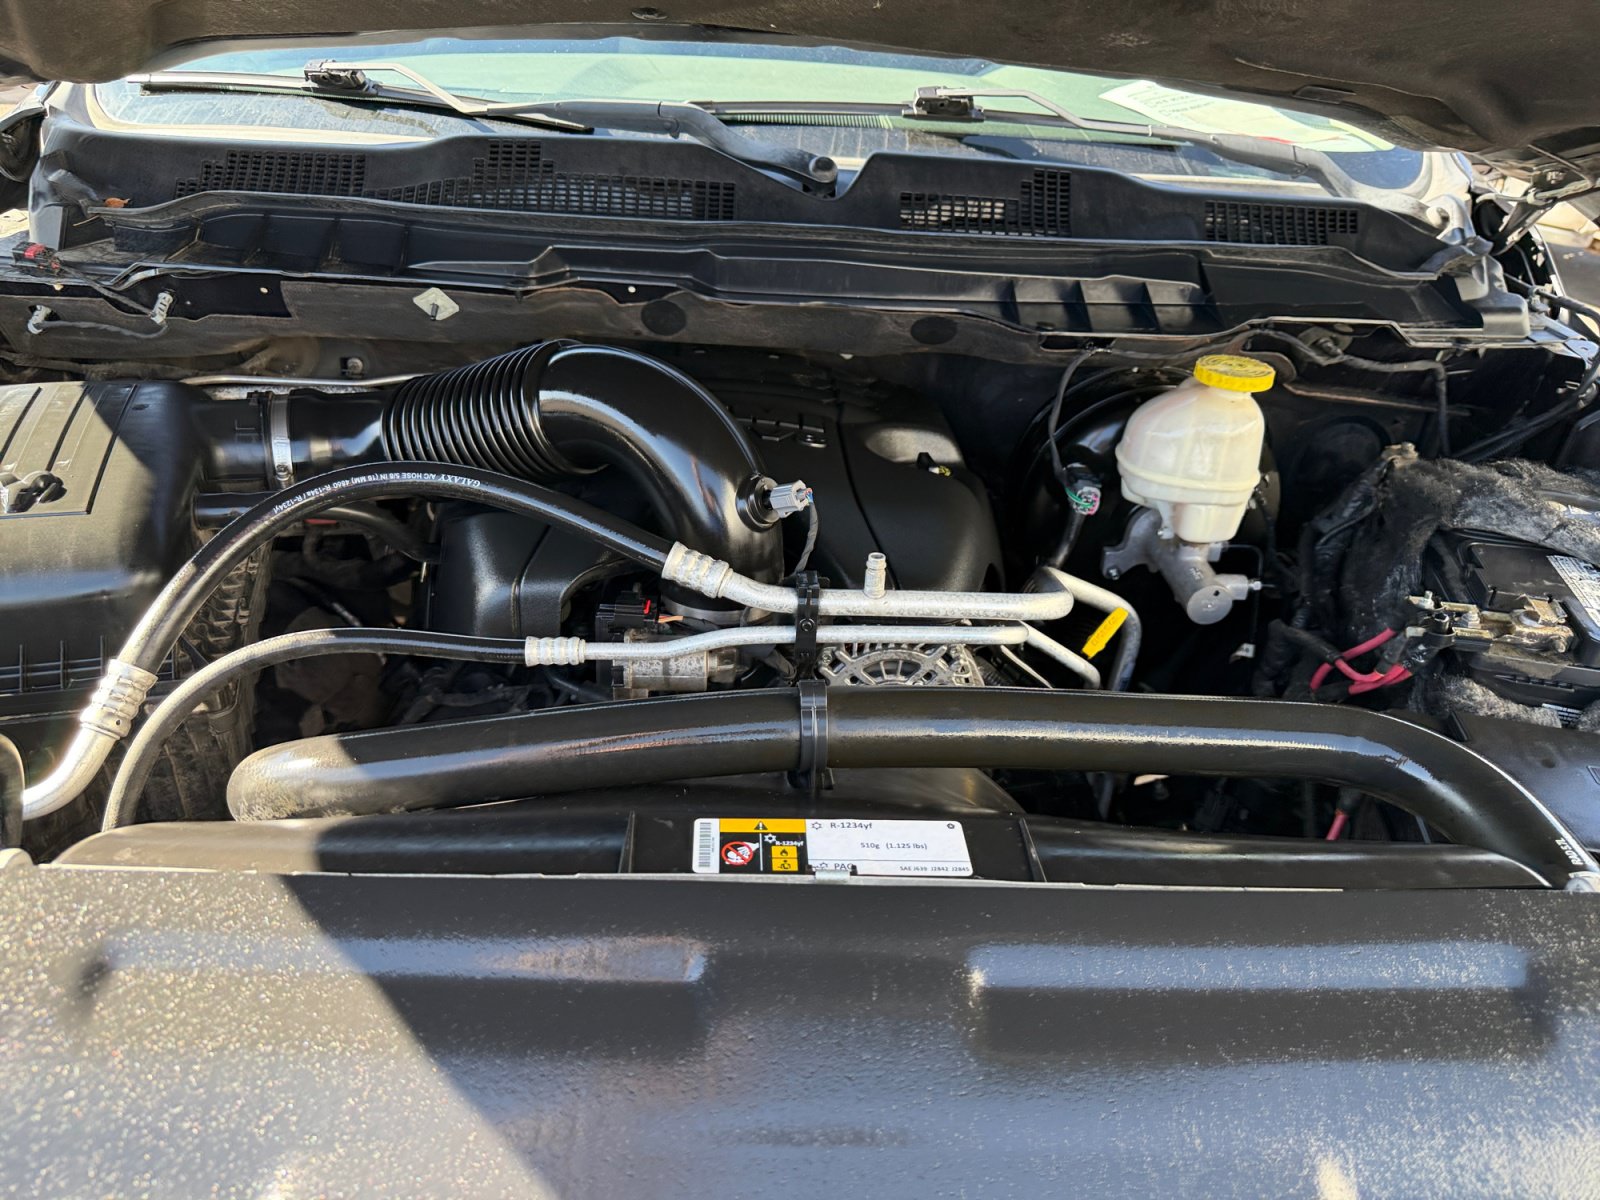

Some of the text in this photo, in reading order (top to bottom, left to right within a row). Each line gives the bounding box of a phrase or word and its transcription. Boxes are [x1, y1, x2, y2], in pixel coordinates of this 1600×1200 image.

[351, 475, 367, 485] MM)
[379, 473, 388, 481] IN
[389, 472, 400, 480] 5/8
[402, 472, 422, 480] HOSE
[423, 473, 436, 481] A/C
[439, 473, 480, 488] GALAXY
[306, 484, 331, 497] R-134a
[272, 494, 303, 514] R-1234yf
[830, 822, 873, 830] R-1234yf
[861, 842, 928, 850] 510g (1.125 lbs)
